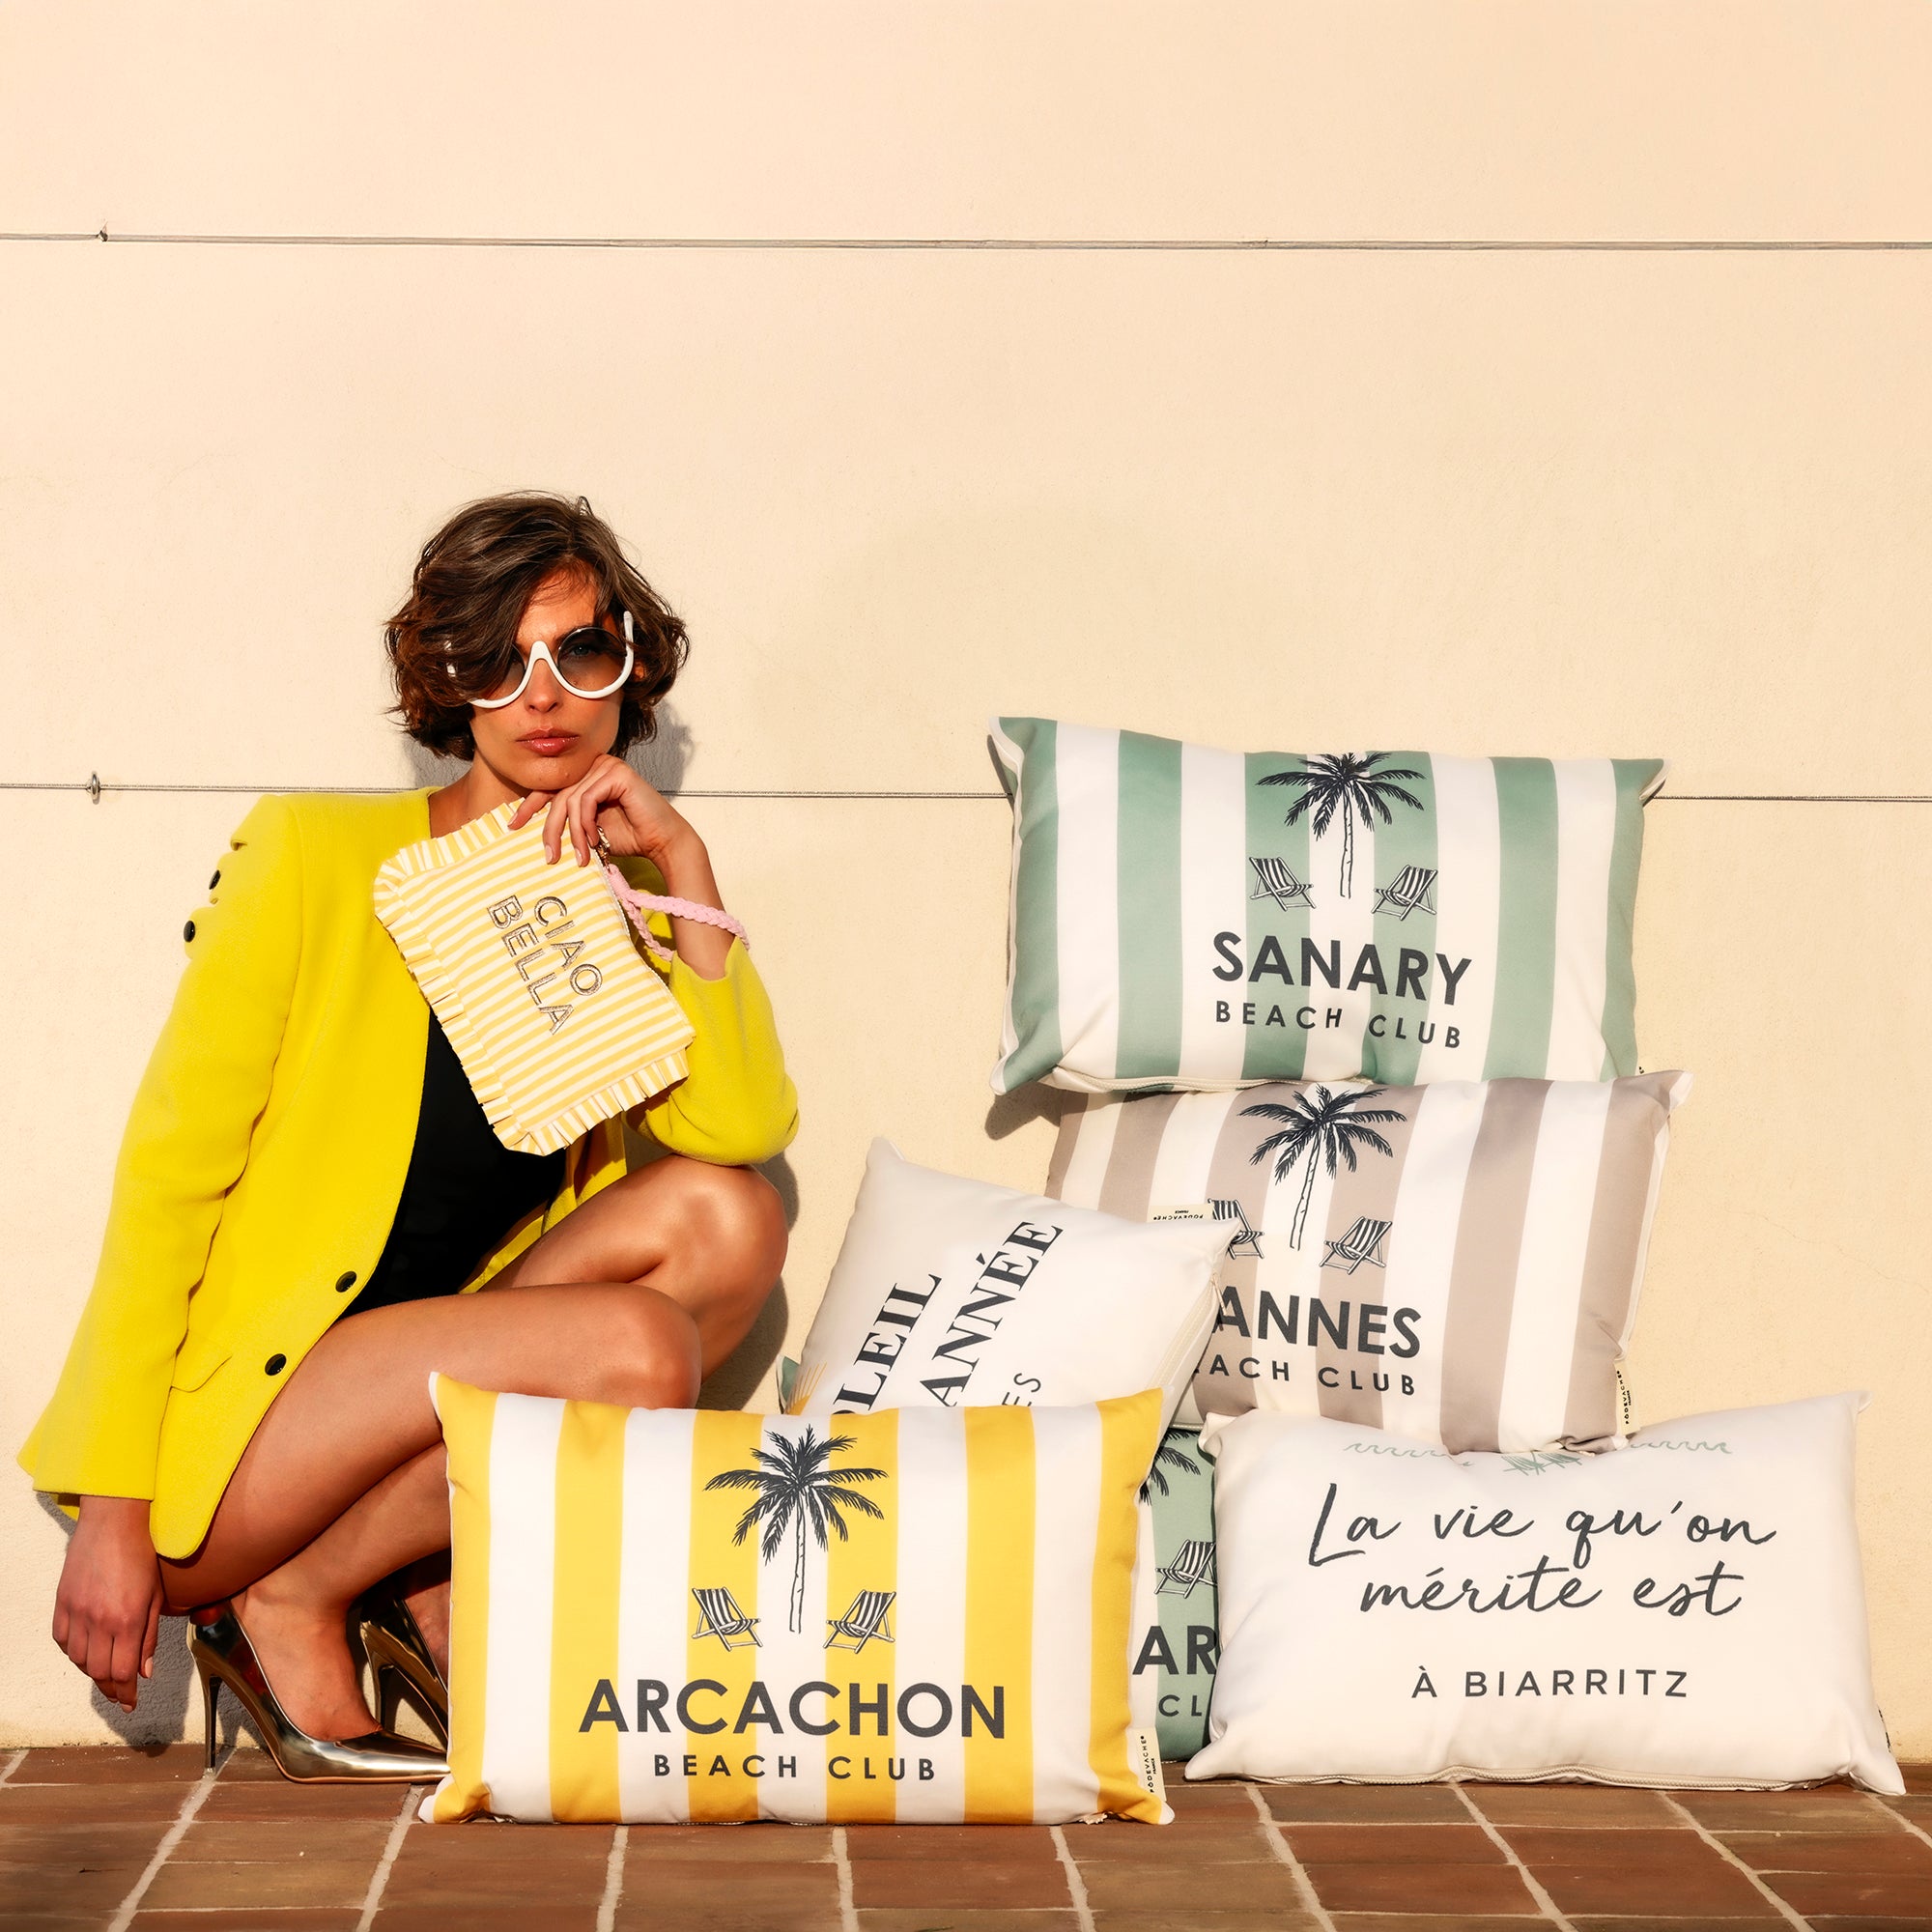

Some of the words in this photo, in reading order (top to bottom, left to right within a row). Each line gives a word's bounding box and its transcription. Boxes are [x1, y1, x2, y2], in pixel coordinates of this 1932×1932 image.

[486, 894, 575, 1036] BELLA
[533, 895, 603, 996] CIAO
[1212, 930, 1472, 1007] SANARY
[1216, 1001, 1343, 1030] BEACH
[1368, 1014, 1461, 1048] CLUB
[833, 1273, 943, 1415] LEIL
[919, 1221, 1065, 1407] ANNÉE
[1210, 1285, 1422, 1359] ANNES
[1194, 1353, 1290, 1381] ACH
[1318, 1366, 1415, 1396] CLUB
[1308, 1483, 1402, 1567] La
[1435, 1506, 1535, 1540] vie
[1565, 1500, 1776, 1569] qu'on
[1360, 1554, 1603, 1613] mérite
[1633, 1560, 1745, 1617] est
[579, 1678, 1006, 1739] ARCACHON
[1411, 1665, 1437, 1699] À
[1464, 1668, 1688, 1698] BIARRITZ
[654, 1753, 797, 1777] BEACH
[828, 1756, 936, 1781] CLUB
